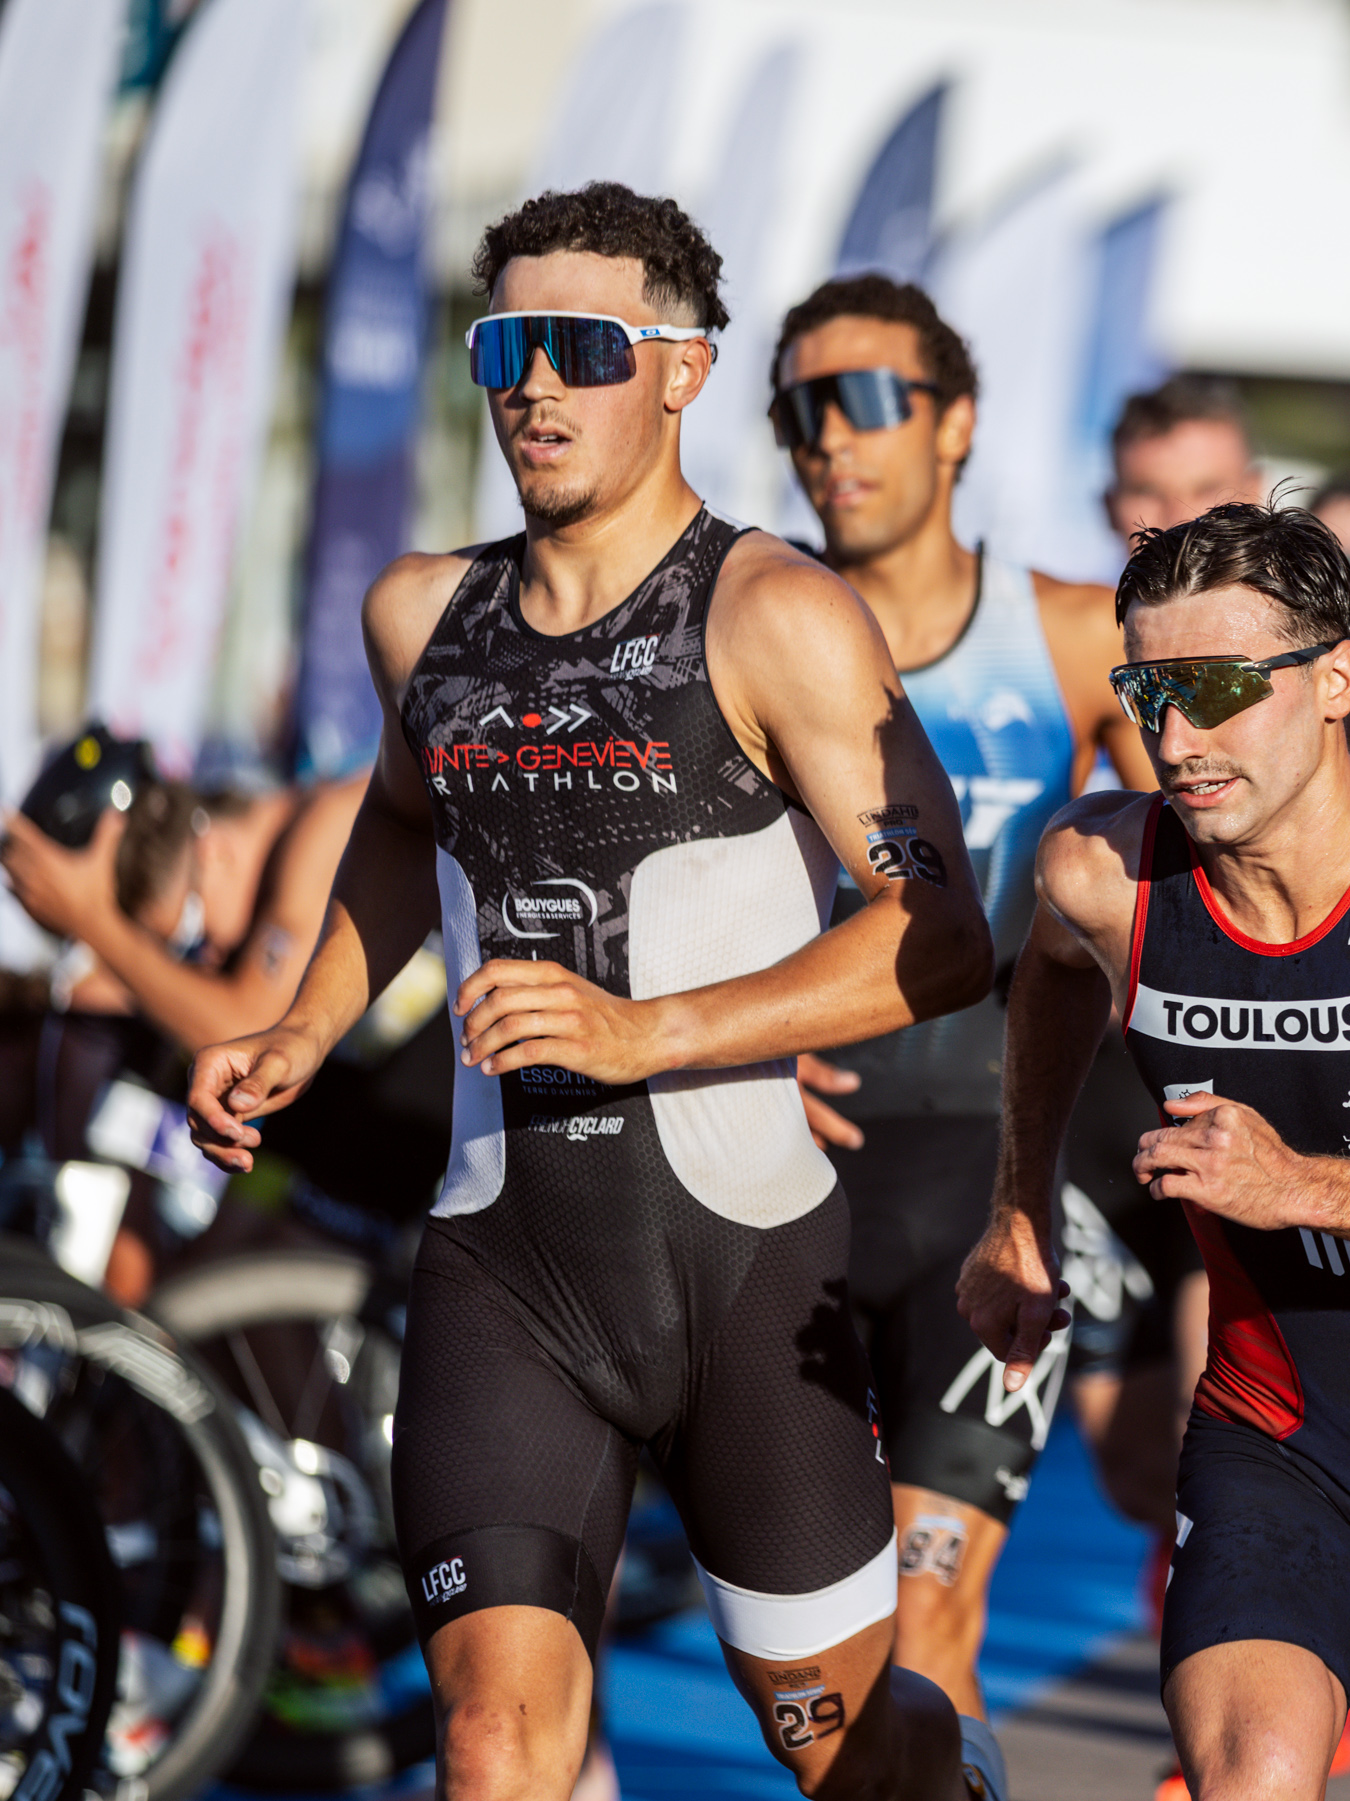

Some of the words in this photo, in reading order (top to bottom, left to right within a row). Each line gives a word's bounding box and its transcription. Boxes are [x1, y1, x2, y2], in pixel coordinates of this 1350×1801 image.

[610, 635, 659, 673] LFCC
[426, 771, 678, 798] RIATHLON
[866, 836, 948, 889] 29
[514, 897, 581, 913] BOUYGUES
[421, 1558, 466, 1602] LFCC
[772, 1692, 846, 1751] 29
